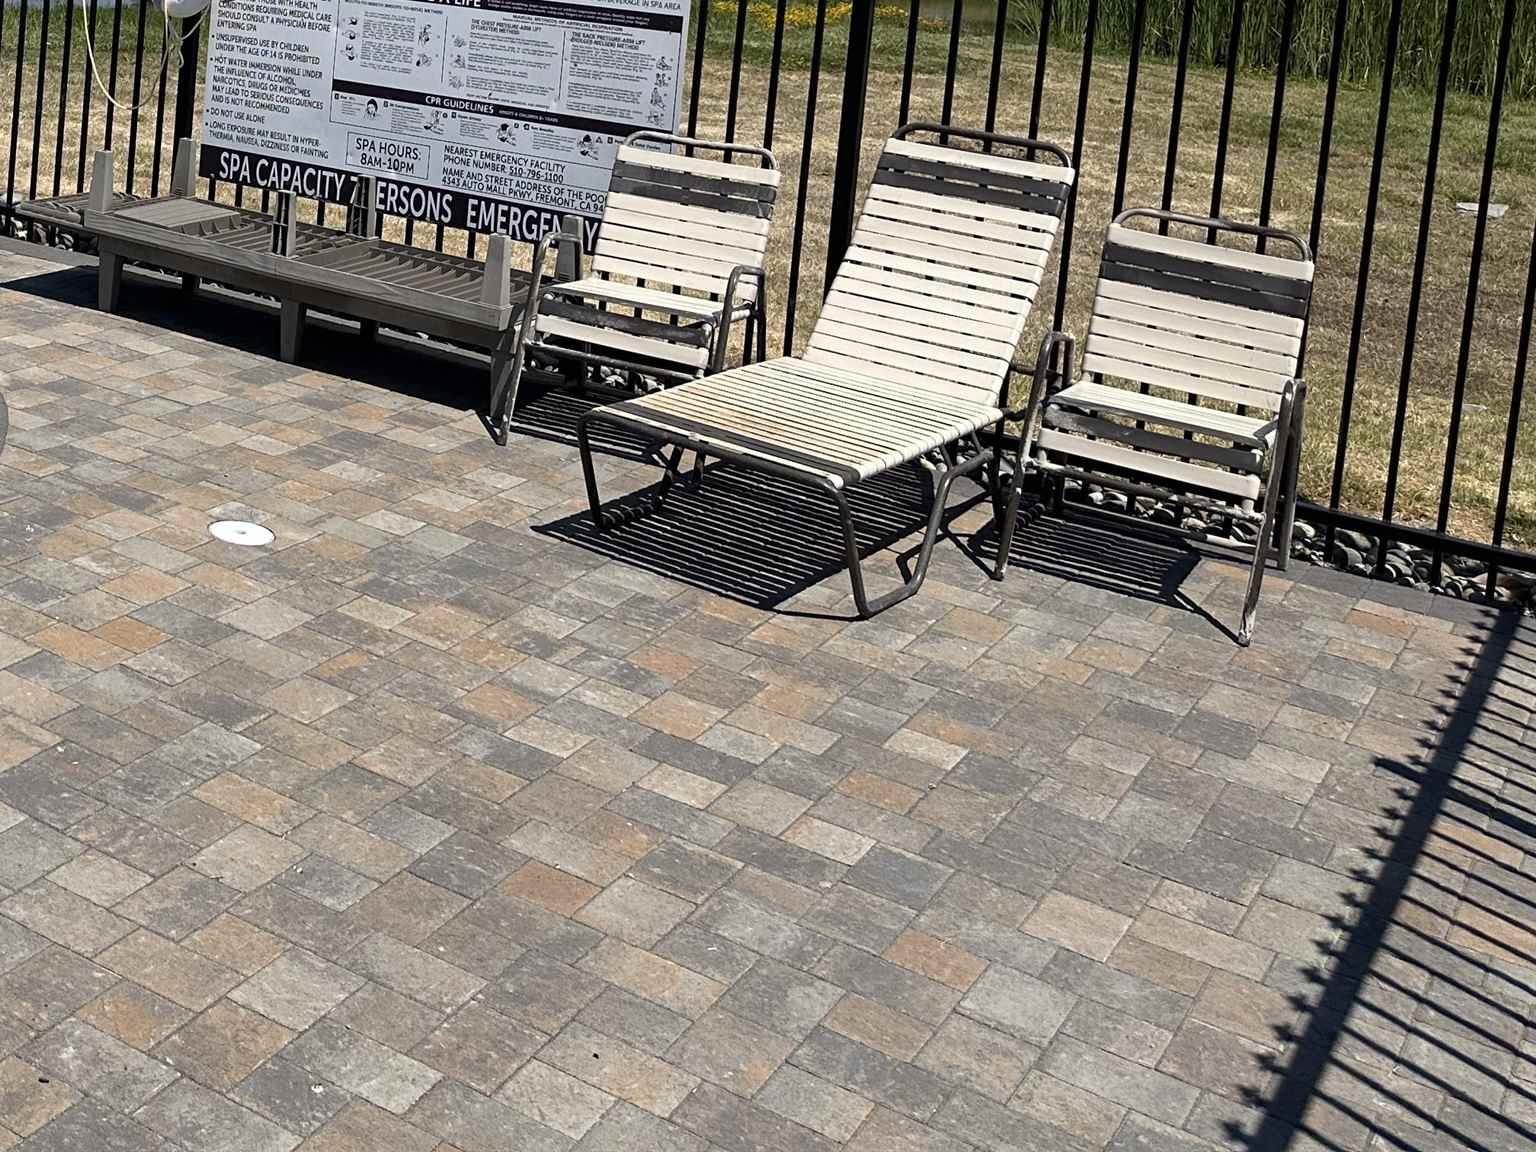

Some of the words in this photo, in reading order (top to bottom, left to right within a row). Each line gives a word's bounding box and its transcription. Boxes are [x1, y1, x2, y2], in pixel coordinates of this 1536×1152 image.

[218, 0, 254, 12] CONDITIONS
[256, 5, 287, 16] REQUIRING
[289, 9, 314, 20] MEDICAL
[316, 13, 332, 22] CARE
[295, 0, 317, 10] HEALTH
[641, 0, 649, 7] IN
[650, 0, 663, 8] SPA
[664, 2, 681, 10] AREA
[217, 10, 241, 20] SHOULD
[242, 13, 269, 24] CONSULT
[275, 17, 306, 29] PHYSICIAN
[307, 22, 330, 32] BEFORE
[217, 19, 245, 30] ENTERING
[246, 23, 256, 31] SPA
[215, 42, 234, 52] UNDER
[235, 45, 247, 54] THE
[248, 47, 259, 56] AGE
[260, 49, 269, 57] OF
[278, 51, 283, 59] IS
[284, 52, 319, 64] PROHIBITED
[216, 33, 258, 45] UNSUPERVISED
[259, 39, 270, 47] USE
[279, 42, 309, 53] CHILDREN
[214, 56, 226, 64] HOT
[228, 58, 247, 67] WATER
[248, 61, 281, 72] IMMERSION
[283, 66, 300, 75] WHILE
[301, 69, 322, 79] UNDER
[214, 65, 224, 73] THE
[226, 67, 256, 78] INFLUENCE
[257, 72, 266, 80] OF
[212, 84, 223, 93] MAY
[225, 87, 239, 96] LEAD
[241, 89, 248, 97] TO
[250, 91, 274, 101] SERIOUS
[275, 95, 323, 109] CONSEQUENCES
[248, 80, 267, 90] DRUGS
[269, 83, 277, 92] OR
[279, 85, 310, 97] MEDICINES
[211, 94, 223, 103] AND
[224, 96, 229, 104] IS
[231, 97, 243, 106] NOT
[245, 100, 289, 114] RECOMMENDED
[425, 95, 441, 105] CPR
[443, 98, 494, 113] GUIDELINES
[220, 109, 232, 118] NOT
[234, 112, 244, 120] USE
[246, 114, 264, 123] ALONE
[209, 121, 225, 130] LONG
[227, 124, 256, 135] EXPOSURE
[257, 129, 269, 137] MAY
[270, 131, 291, 141] RESULT
[292, 135, 298, 143] IN
[260, 139, 289, 151] DIZZINESS
[290, 144, 299, 153] OR
[300, 146, 328, 158] FAINTING
[355, 138, 376, 152] SPA
[379, 142, 421, 160] HOURS:
[444, 145, 478, 159] NEAREST
[480, 151, 527, 167] EMERGENCY
[530, 159, 565, 173] FACILITY
[360, 153, 414, 173] 8AM-10PM
[443, 155, 470, 167] PHONE
[509, 166, 563, 183] 510-796-1100
[442, 167, 464, 178] NAME
[466, 171, 482, 182] AND
[484, 174, 512, 187] STREET
[515, 179, 551, 194] ADDRESS
[553, 186, 566, 196] OF
[568, 189, 584, 200] THE
[218, 151, 252, 184] SPA
[255, 157, 345, 202] CAPACITY
[375, 179, 453, 223] ERSONS
[466, 198, 598, 253] EMERGENY
[462, 180, 483, 191] AUTO
[486, 184, 506, 195] MALL
[580, 201, 591, 210] CA
